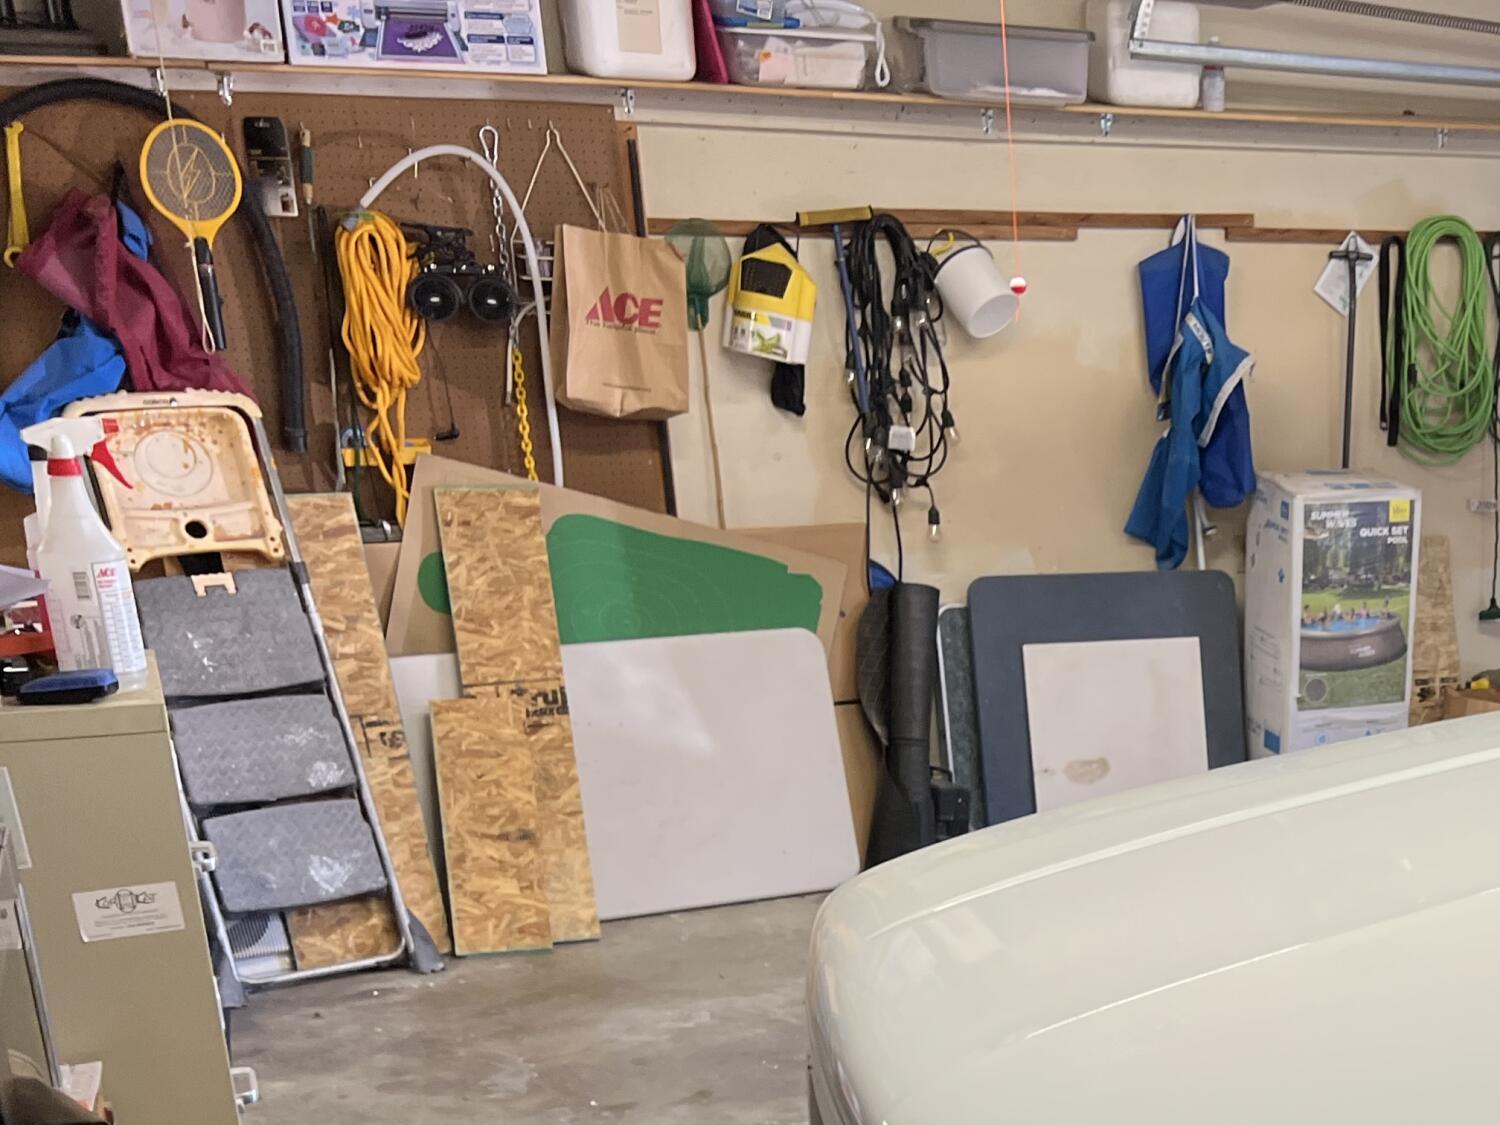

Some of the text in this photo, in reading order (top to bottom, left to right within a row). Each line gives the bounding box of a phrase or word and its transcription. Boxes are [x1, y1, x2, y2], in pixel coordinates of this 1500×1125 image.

[585, 286, 663, 328] ACE
[1360, 525, 1409, 538] QUICK SET
[1387, 536, 1408, 545] POOL
